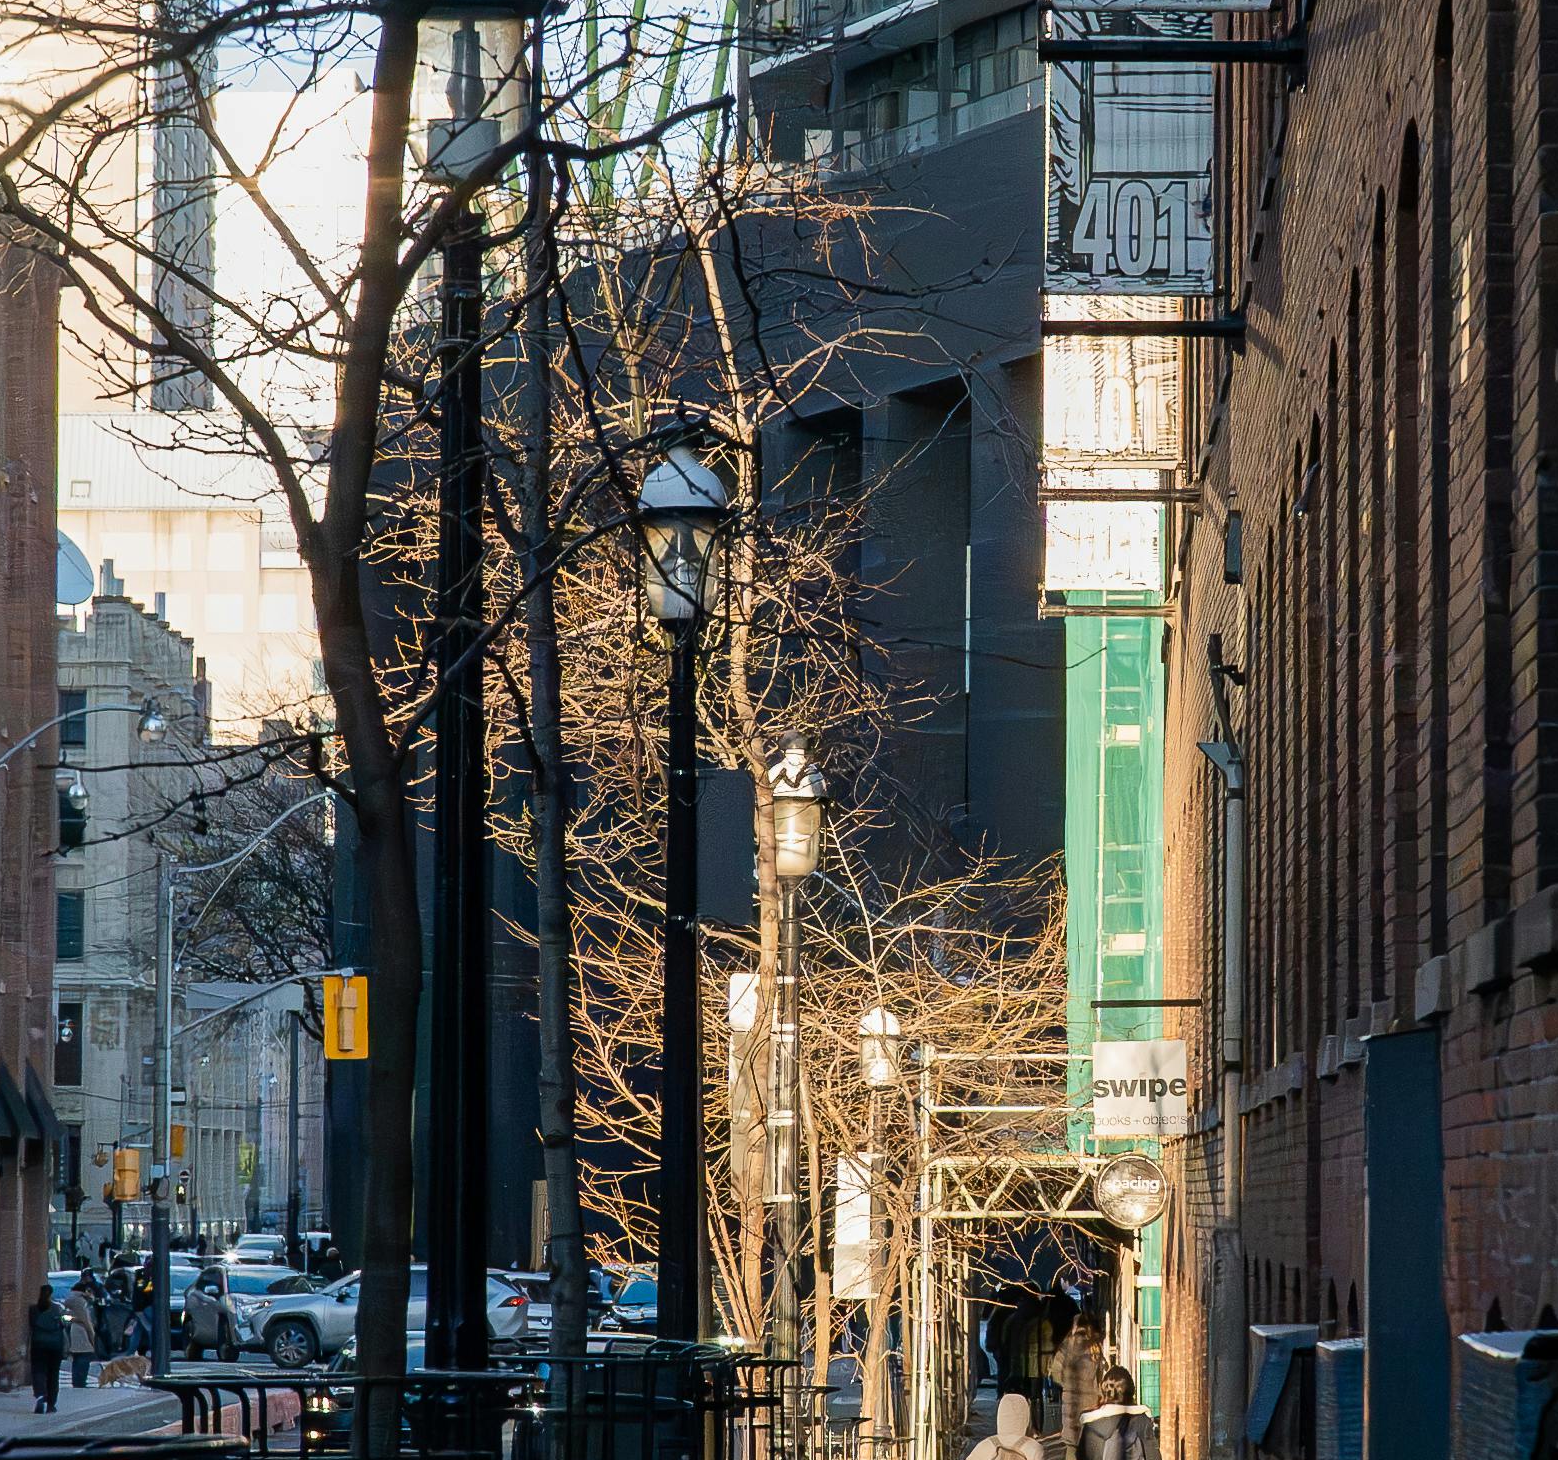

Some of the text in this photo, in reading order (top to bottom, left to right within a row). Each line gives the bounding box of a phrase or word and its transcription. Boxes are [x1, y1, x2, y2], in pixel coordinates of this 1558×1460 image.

[1072, 180, 1189, 278] 401
[1093, 1077, 1187, 1102] swipe
[1105, 1175, 1160, 1194] spacing
